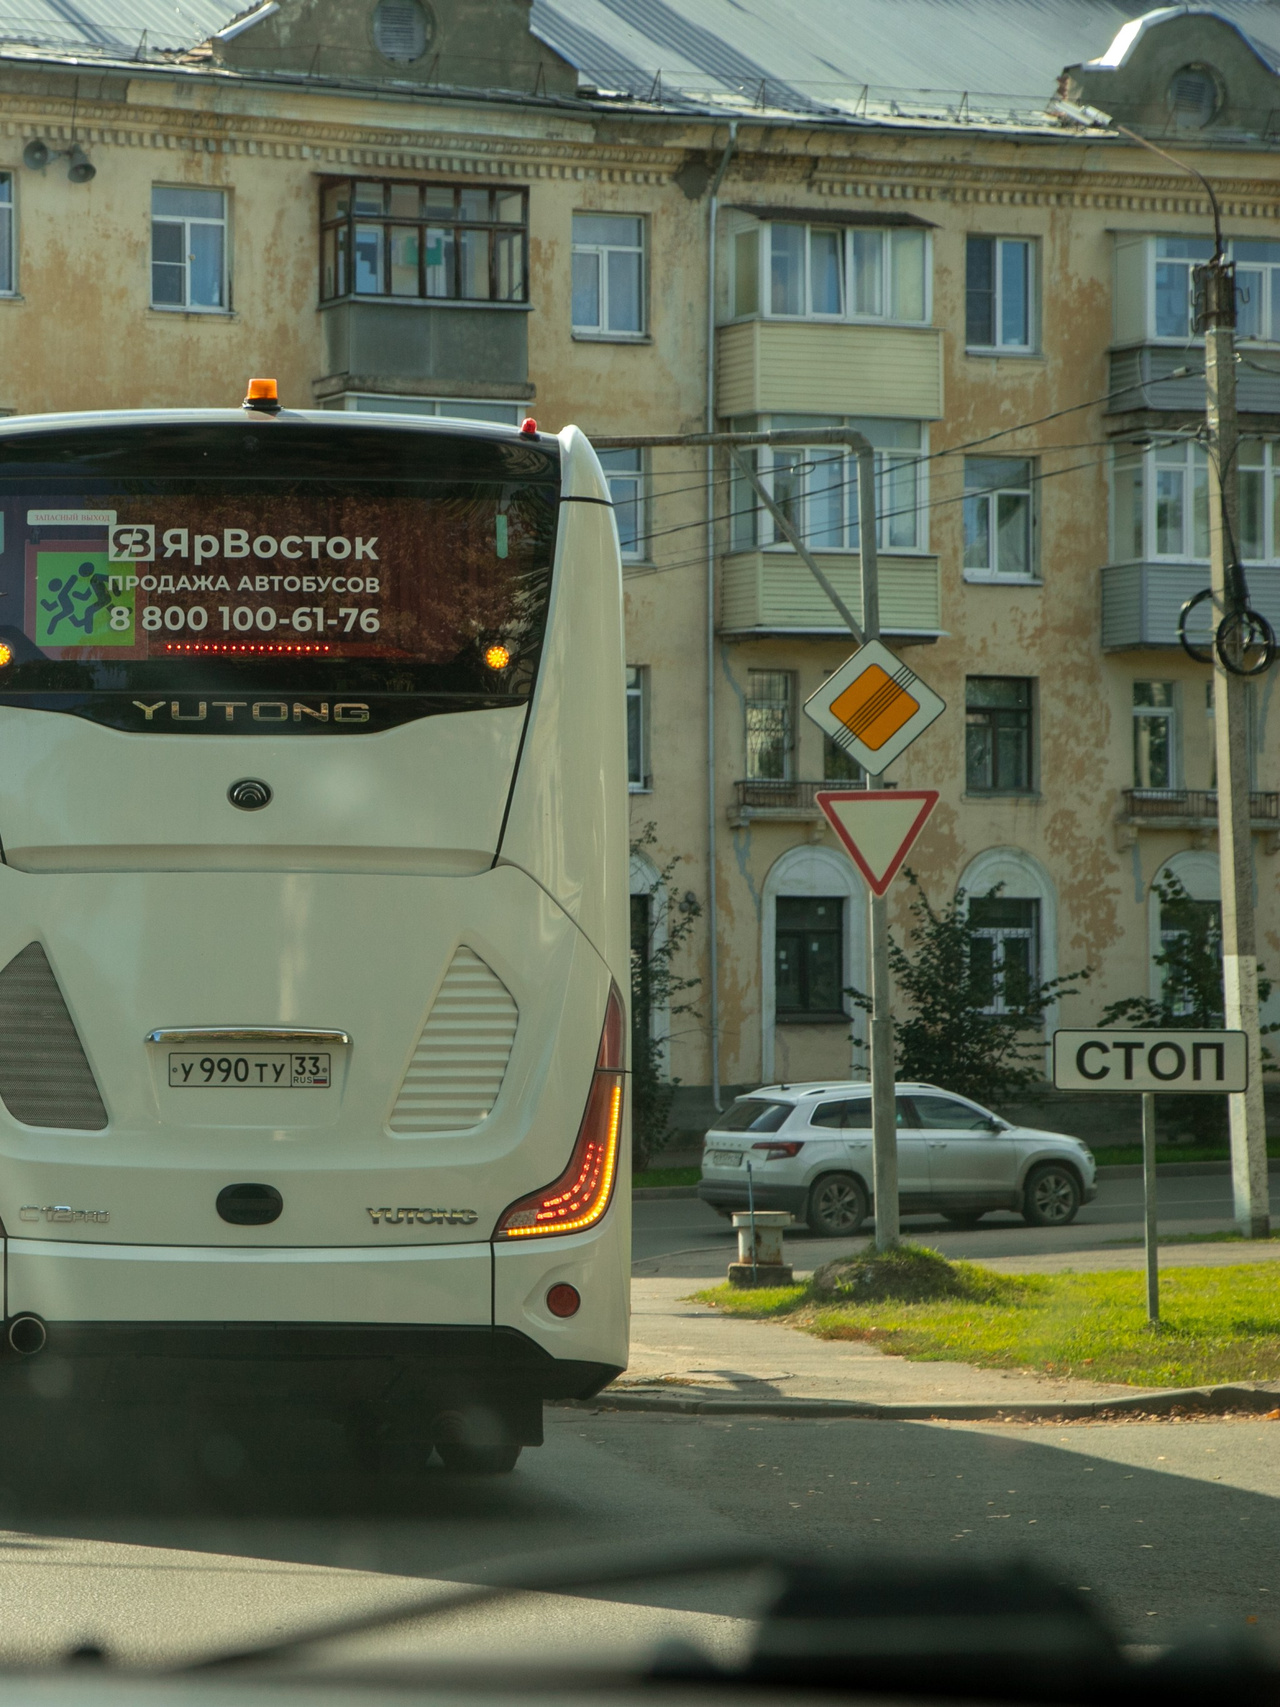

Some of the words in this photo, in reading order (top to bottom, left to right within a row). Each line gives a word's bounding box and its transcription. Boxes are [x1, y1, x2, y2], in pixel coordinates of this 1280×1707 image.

[34, 513, 78, 522] ЗАПАСНЫЙ
[81, 514, 111, 523] ВЫХОД
[162, 528, 380, 566] ЯрВосток
[108, 575, 231, 593] ПРОДАЖА
[237, 575, 380, 594] АВТОБУСОВ
[109, 606, 131, 631] 8
[141, 605, 209, 631] 800
[218, 605, 381, 633] 100-61-76
[132, 700, 370, 723] YUTONG
[294, 1056, 320, 1076] 33
[1076, 1040, 1225, 1081] СТОП
[293, 1076, 312, 1084] RUS
[366, 1207, 479, 1225] YUTONG
